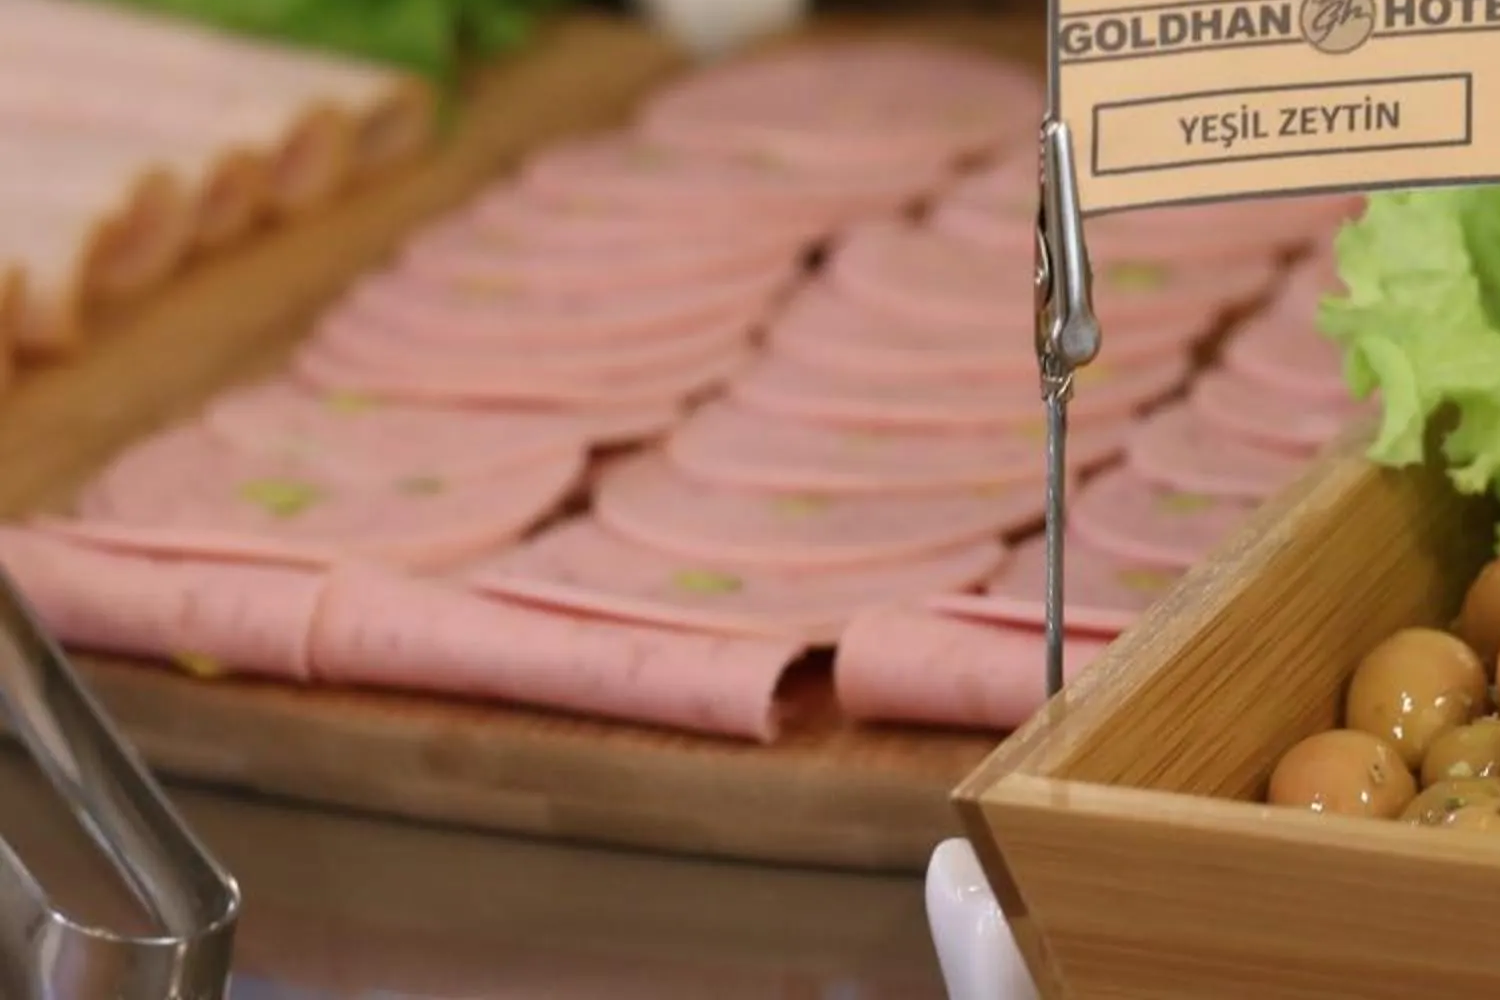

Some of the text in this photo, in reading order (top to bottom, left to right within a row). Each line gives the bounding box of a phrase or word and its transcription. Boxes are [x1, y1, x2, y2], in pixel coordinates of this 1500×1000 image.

[1061, 3, 1292, 55] GOLDHAN
[1180, 96, 1401, 148] YEŞİL ZEYTİN
